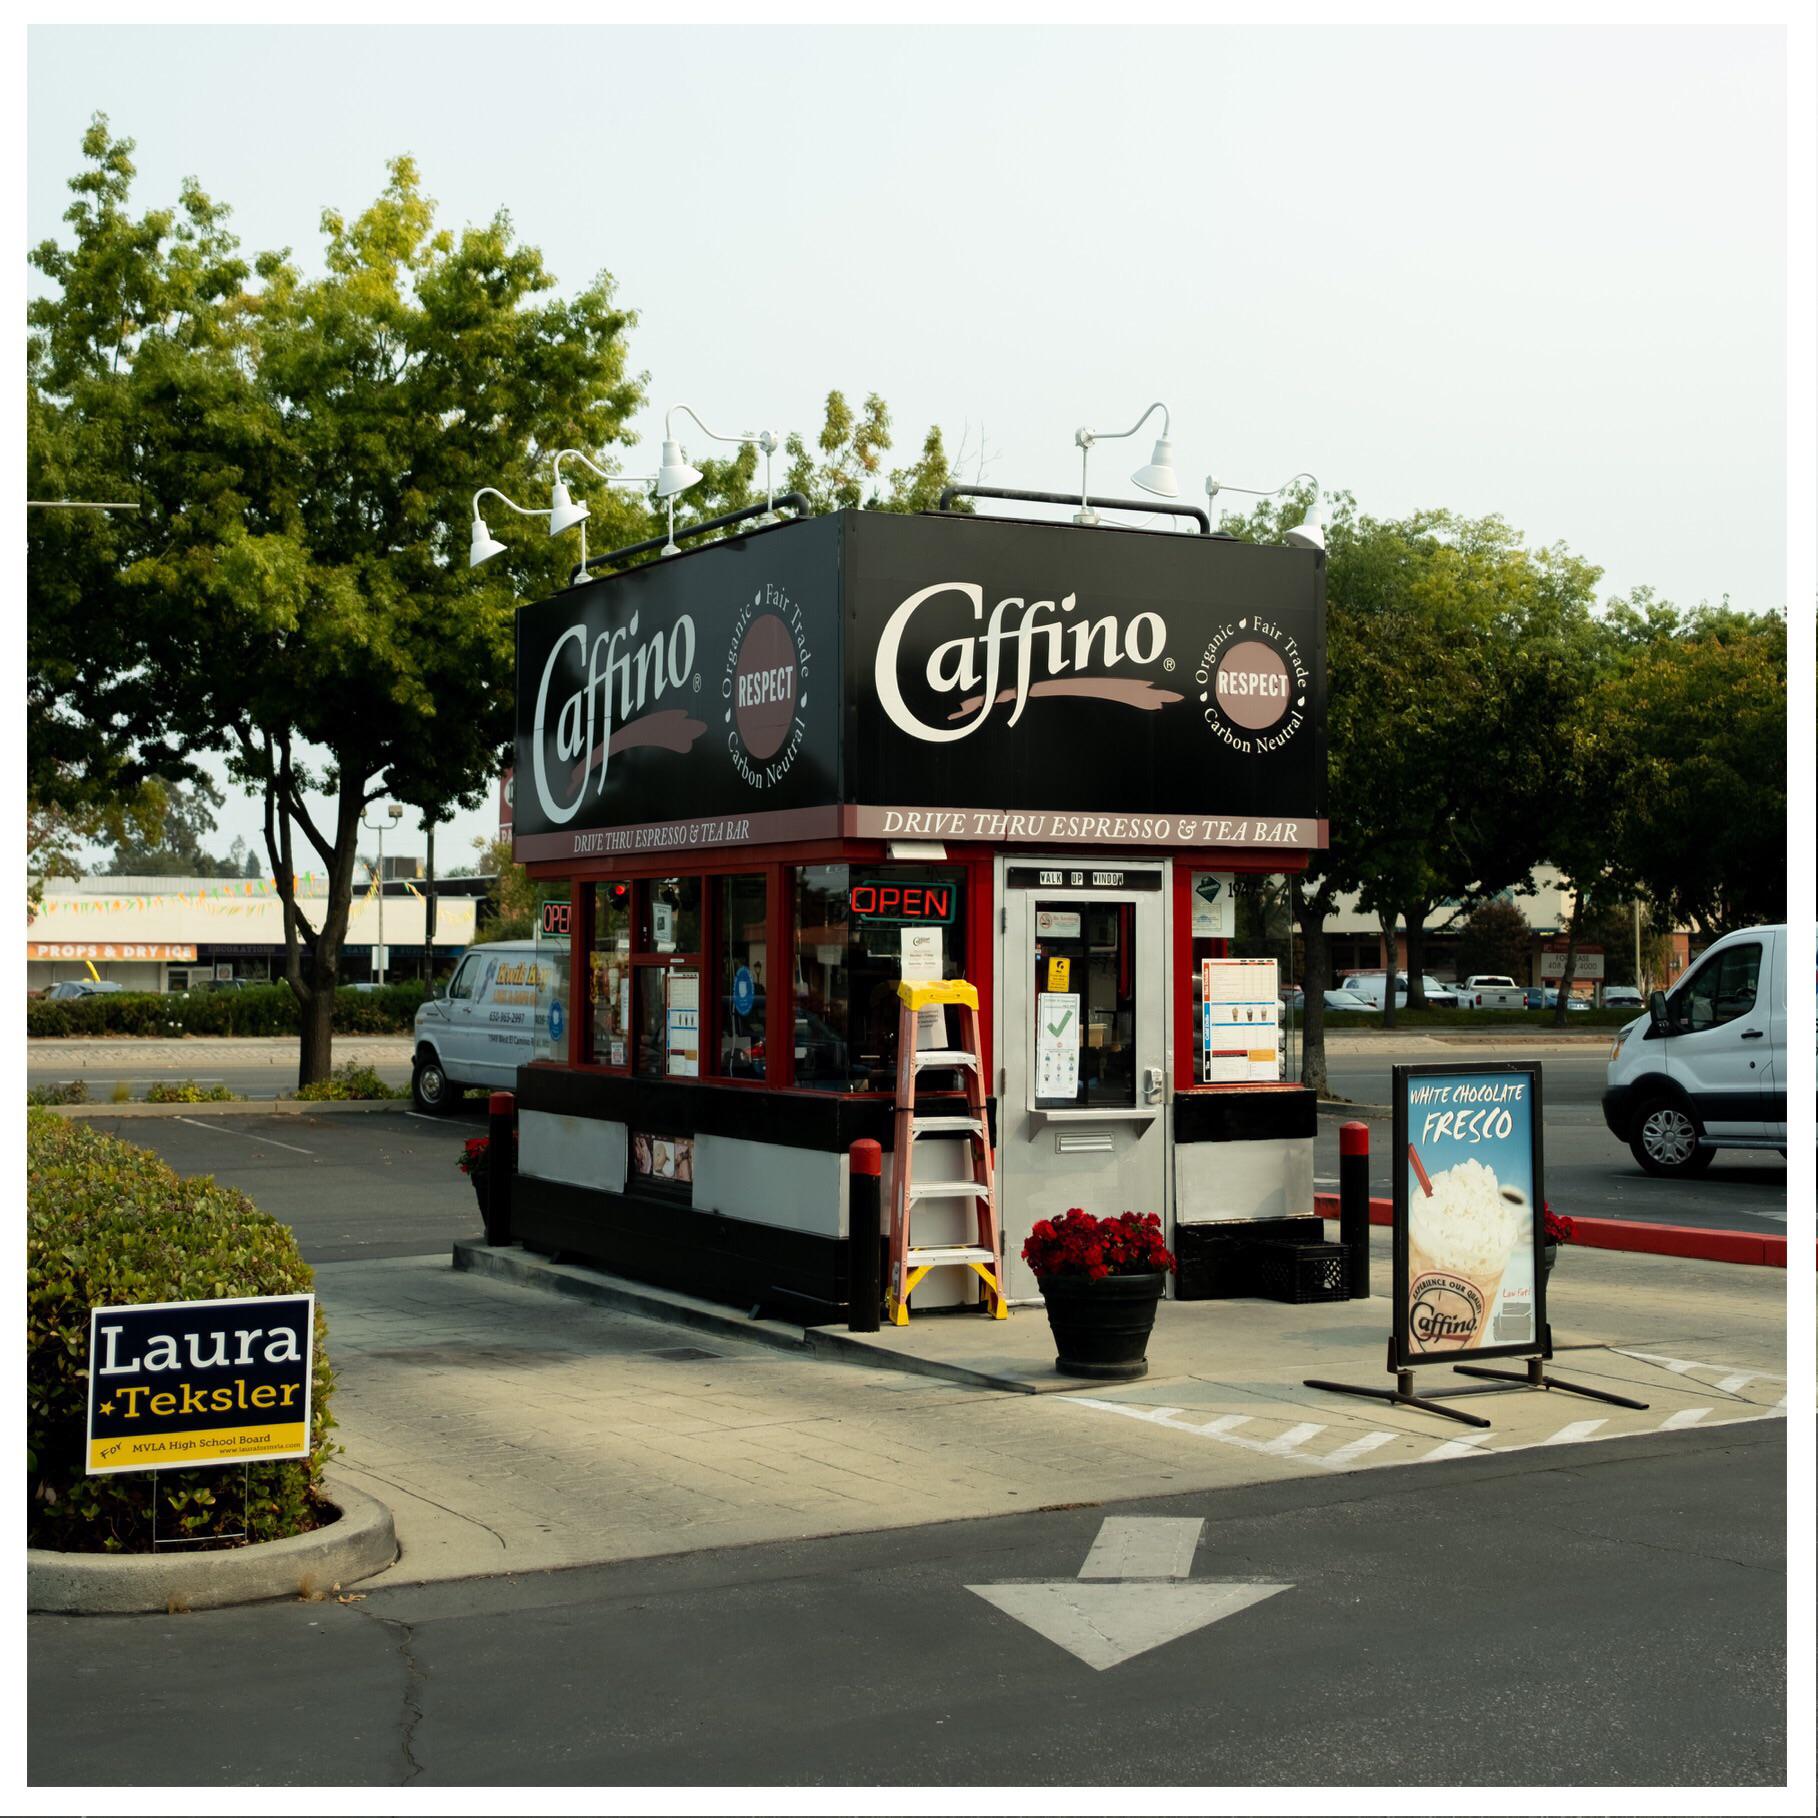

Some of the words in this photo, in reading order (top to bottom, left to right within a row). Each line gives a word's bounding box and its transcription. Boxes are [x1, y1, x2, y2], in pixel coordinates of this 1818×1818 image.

[722, 604, 753, 699] Organic
[766, 584, 790, 614] Fair
[794, 604, 810, 679] Trade
[875, 582, 1167, 742] Caffino
[1195, 623, 1235, 683] Organic
[1253, 616, 1283, 639] Fair
[1285, 638, 1309, 689] Trade
[738, 666, 794, 708] RESPECT
[1218, 670, 1289, 699] RESPECT
[533, 610, 696, 825] Caffino
[1203, 707, 1252, 754] Carbon
[1256, 712, 1306, 754] Neutral
[728, 731, 764, 790] Carbon
[766, 717, 806, 788] Neutral
[574, 834, 604, 853] DRIVE
[605, 831, 633, 849] THRU
[635, 825, 688, 847] ESPRESSO
[689, 825, 699, 844] &
[701, 822, 725, 842] TEA
[727, 820, 750, 840] BAR
[881, 811, 967, 834] DRIVE
[973, 813, 1046, 836] THRU
[1050, 816, 1171, 839] ESPRESSO
[1177, 821, 1198, 840] &
[1201, 822, 1248, 842] TEA
[1254, 823, 1299, 843] BAR
[1040, 872, 1062, 885] WALK
[1071, 872, 1083, 885] UP
[851, 887, 948, 917] OPEN
[38, 945, 97, 958] PROPS
[104, 945, 116, 958] &
[123, 945, 158, 958] DRY
[165, 945, 192, 958] ICE
[1410, 1085, 1452, 1104] WHITE
[1453, 1083, 1525, 1103] CHOCOLATE
[1422, 1109, 1513, 1144] FRESCO
[1449, 1281, 1466, 1292] OUR
[1410, 1302, 1477, 1343] Caffino
[99, 1325, 301, 1375] Laura
[116, 1379, 300, 1419] Teksler
[132, 1442, 166, 1453] MVLA
[169, 1440, 196, 1452] High
[199, 1437, 236, 1448] School
[239, 1434, 271, 1444] Board
